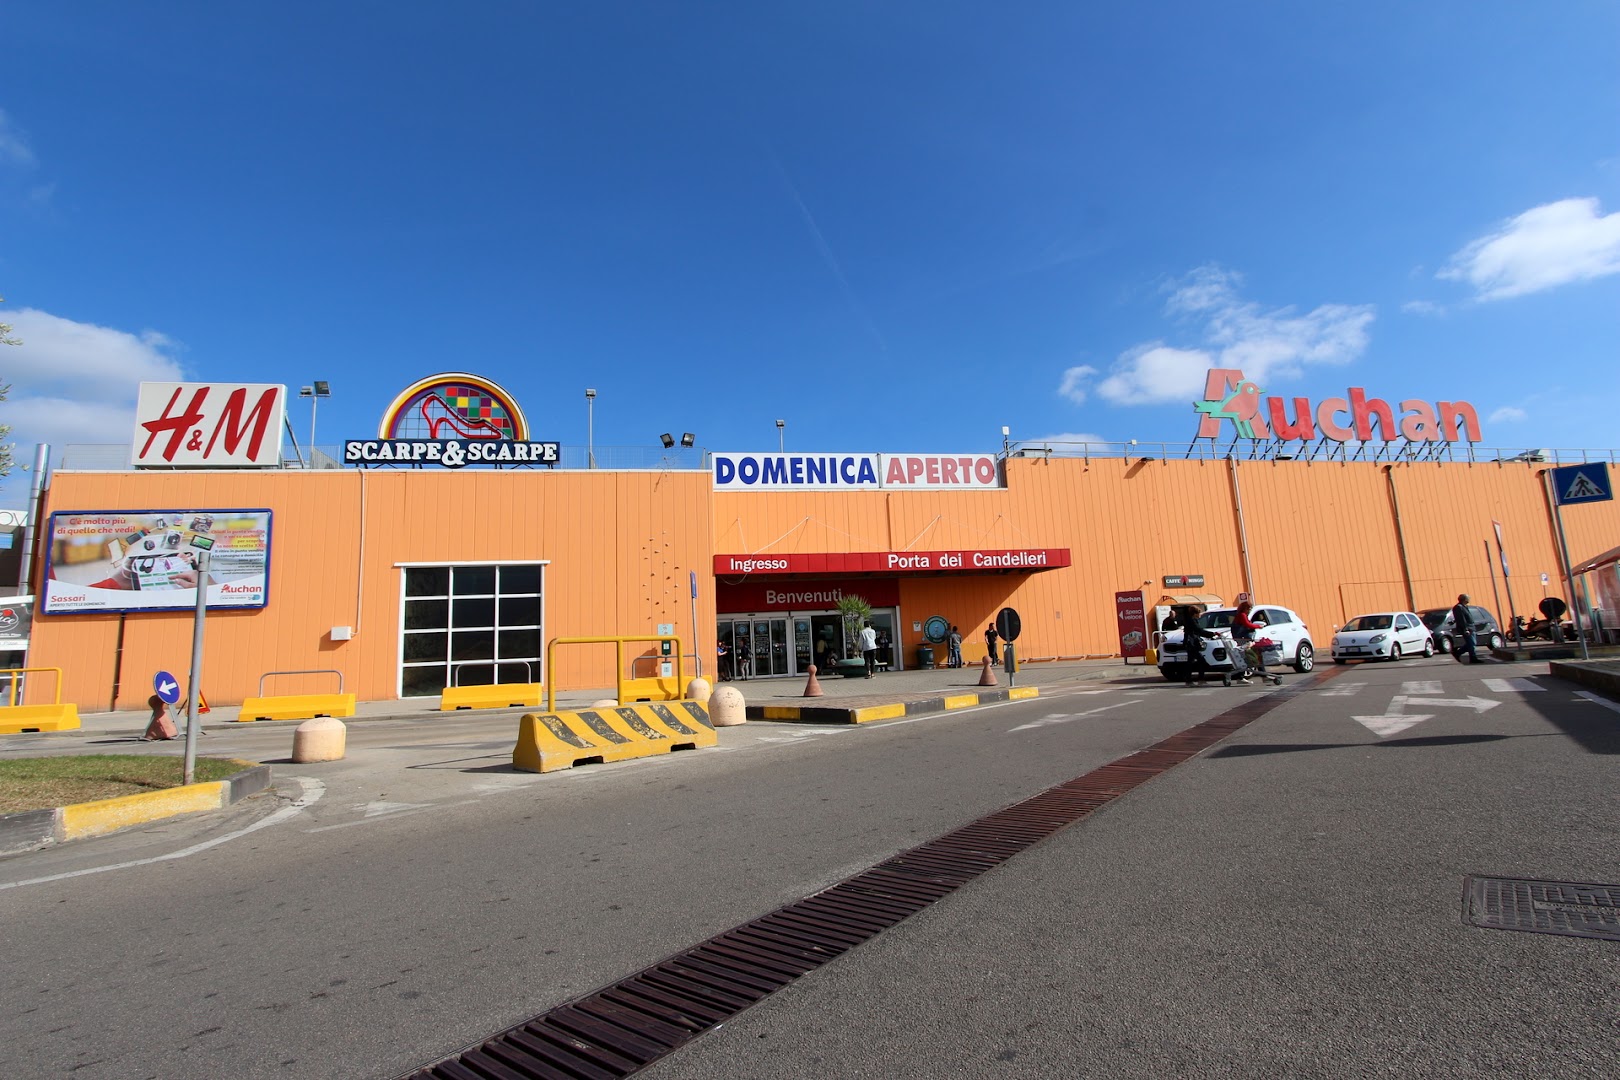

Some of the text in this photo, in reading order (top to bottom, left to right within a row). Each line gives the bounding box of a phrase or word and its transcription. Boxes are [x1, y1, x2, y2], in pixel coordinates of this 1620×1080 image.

[1196, 368, 1482, 442] Auchan
[139, 387, 278, 462] H&M
[715, 457, 996, 485] DOMENICA APERTO
[111, 517, 126, 526] più
[67, 527, 96, 536] quello
[730, 551, 1047, 572] Ingresso Porta dei Candelieri
[221, 584, 262, 593] Auchan
[766, 588, 843, 605] Benvenuti
[51, 594, 86, 603] Sassari
